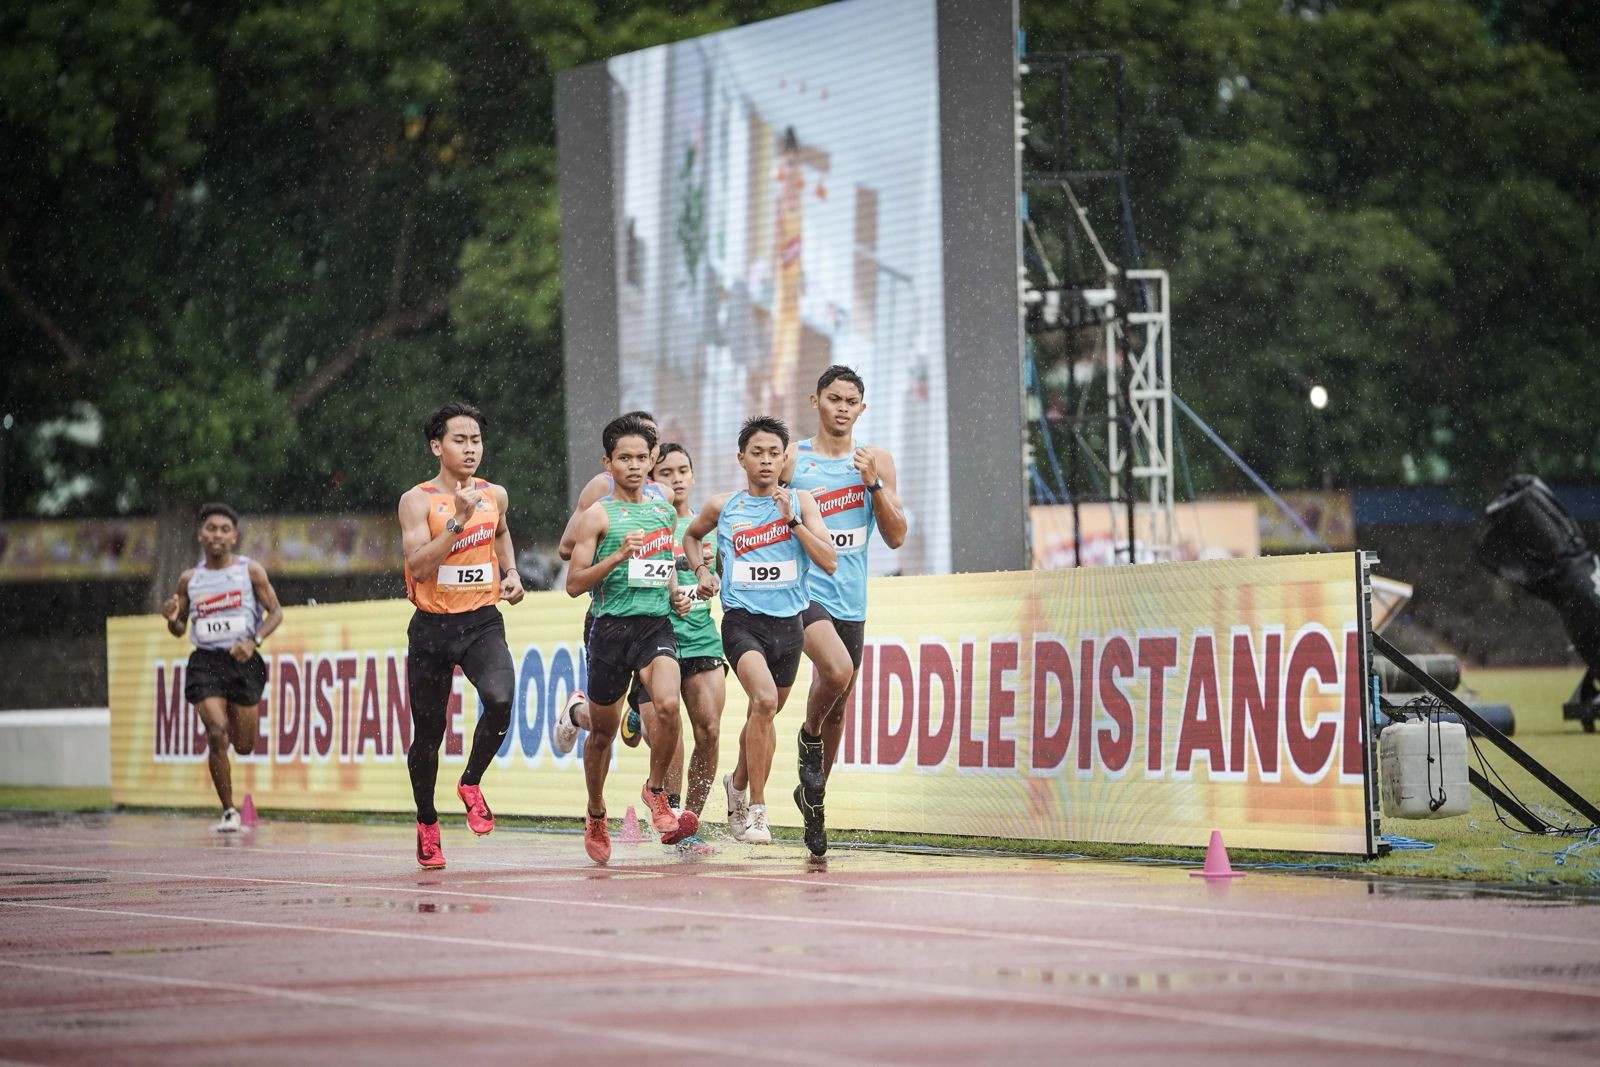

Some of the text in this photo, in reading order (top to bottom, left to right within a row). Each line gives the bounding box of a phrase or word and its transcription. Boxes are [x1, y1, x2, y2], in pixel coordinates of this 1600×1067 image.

[816, 490, 864, 513] hampion
[452, 527, 494, 552] hampion
[735, 523, 789, 551] Champion
[457, 568, 484, 583] 152
[644, 563, 674, 578] 247
[749, 566, 781, 581] 199
[207, 621, 231, 633] 103
[278, 655, 464, 757] DISTANE
